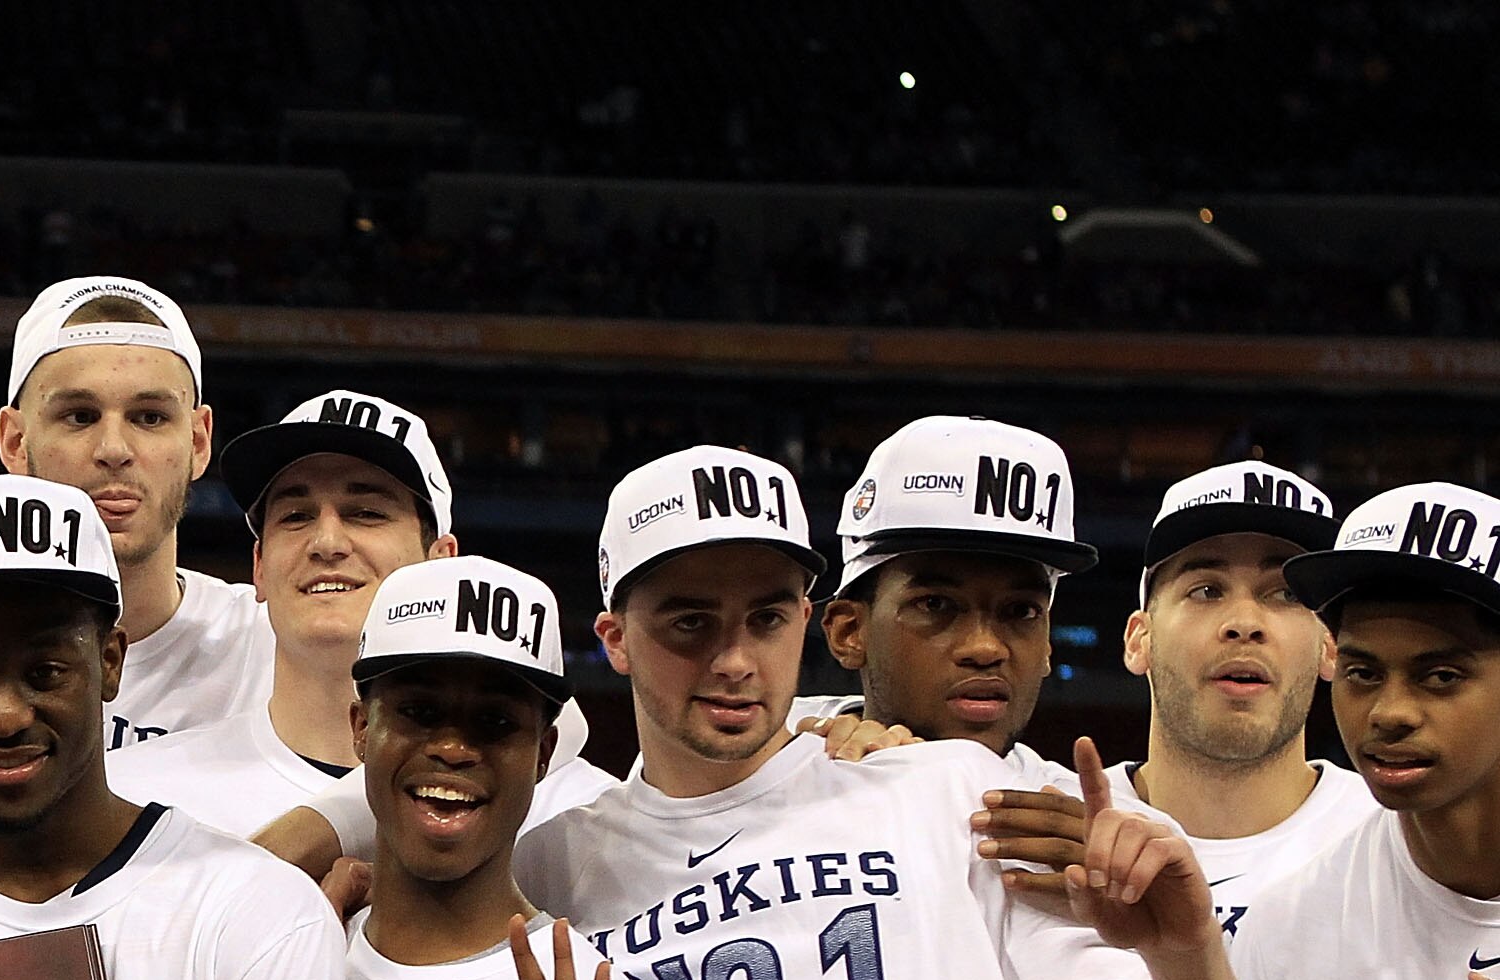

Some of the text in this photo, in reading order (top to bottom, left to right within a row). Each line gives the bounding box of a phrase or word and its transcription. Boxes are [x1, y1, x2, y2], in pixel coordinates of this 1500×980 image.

[903, 474, 964, 495] UCONN
[627, 494, 684, 531] UCONN
[1344, 522, 1397, 546] UCONN
[387, 598, 447, 623] UCONN
